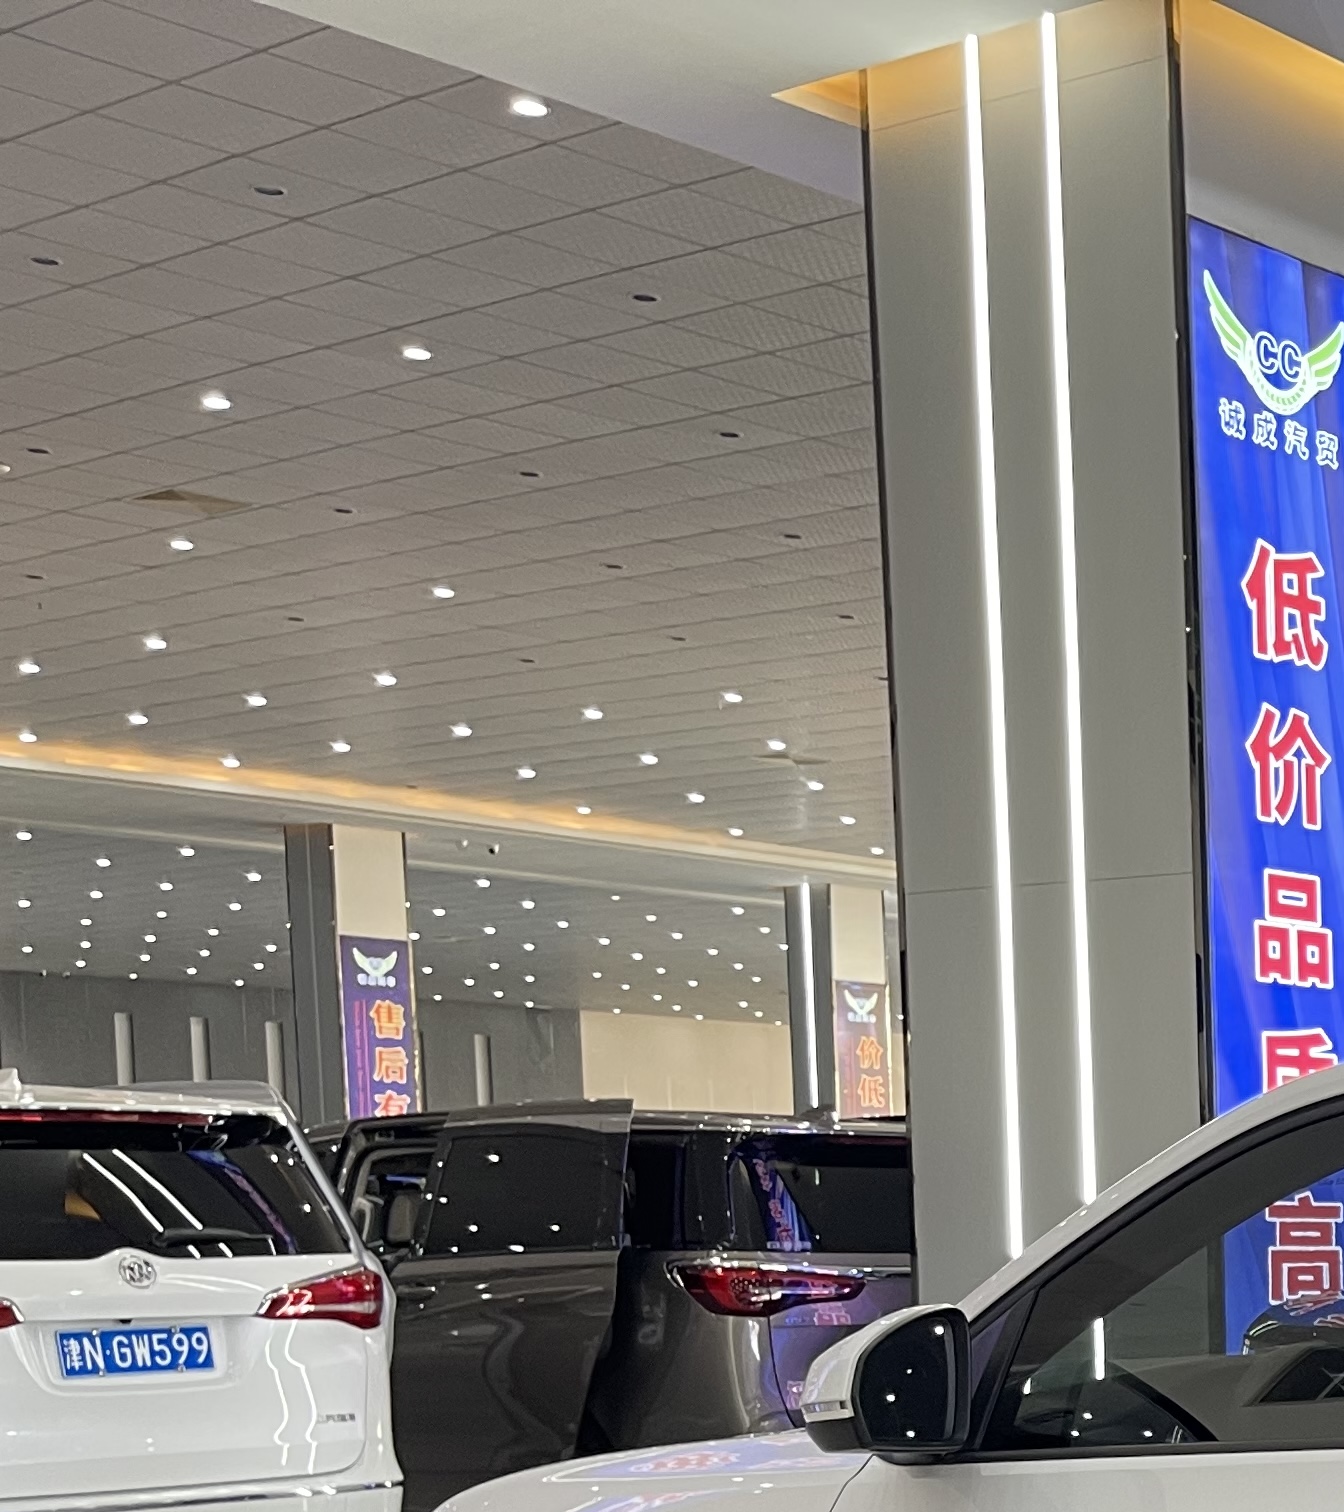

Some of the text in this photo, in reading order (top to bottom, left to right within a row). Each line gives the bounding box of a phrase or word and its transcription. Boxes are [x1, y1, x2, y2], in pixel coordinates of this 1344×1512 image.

[1255, 330, 1302, 381] CC
[1219, 397, 1340, 470] 诚成汽贸
[855, 1035, 885, 1117] 价低
